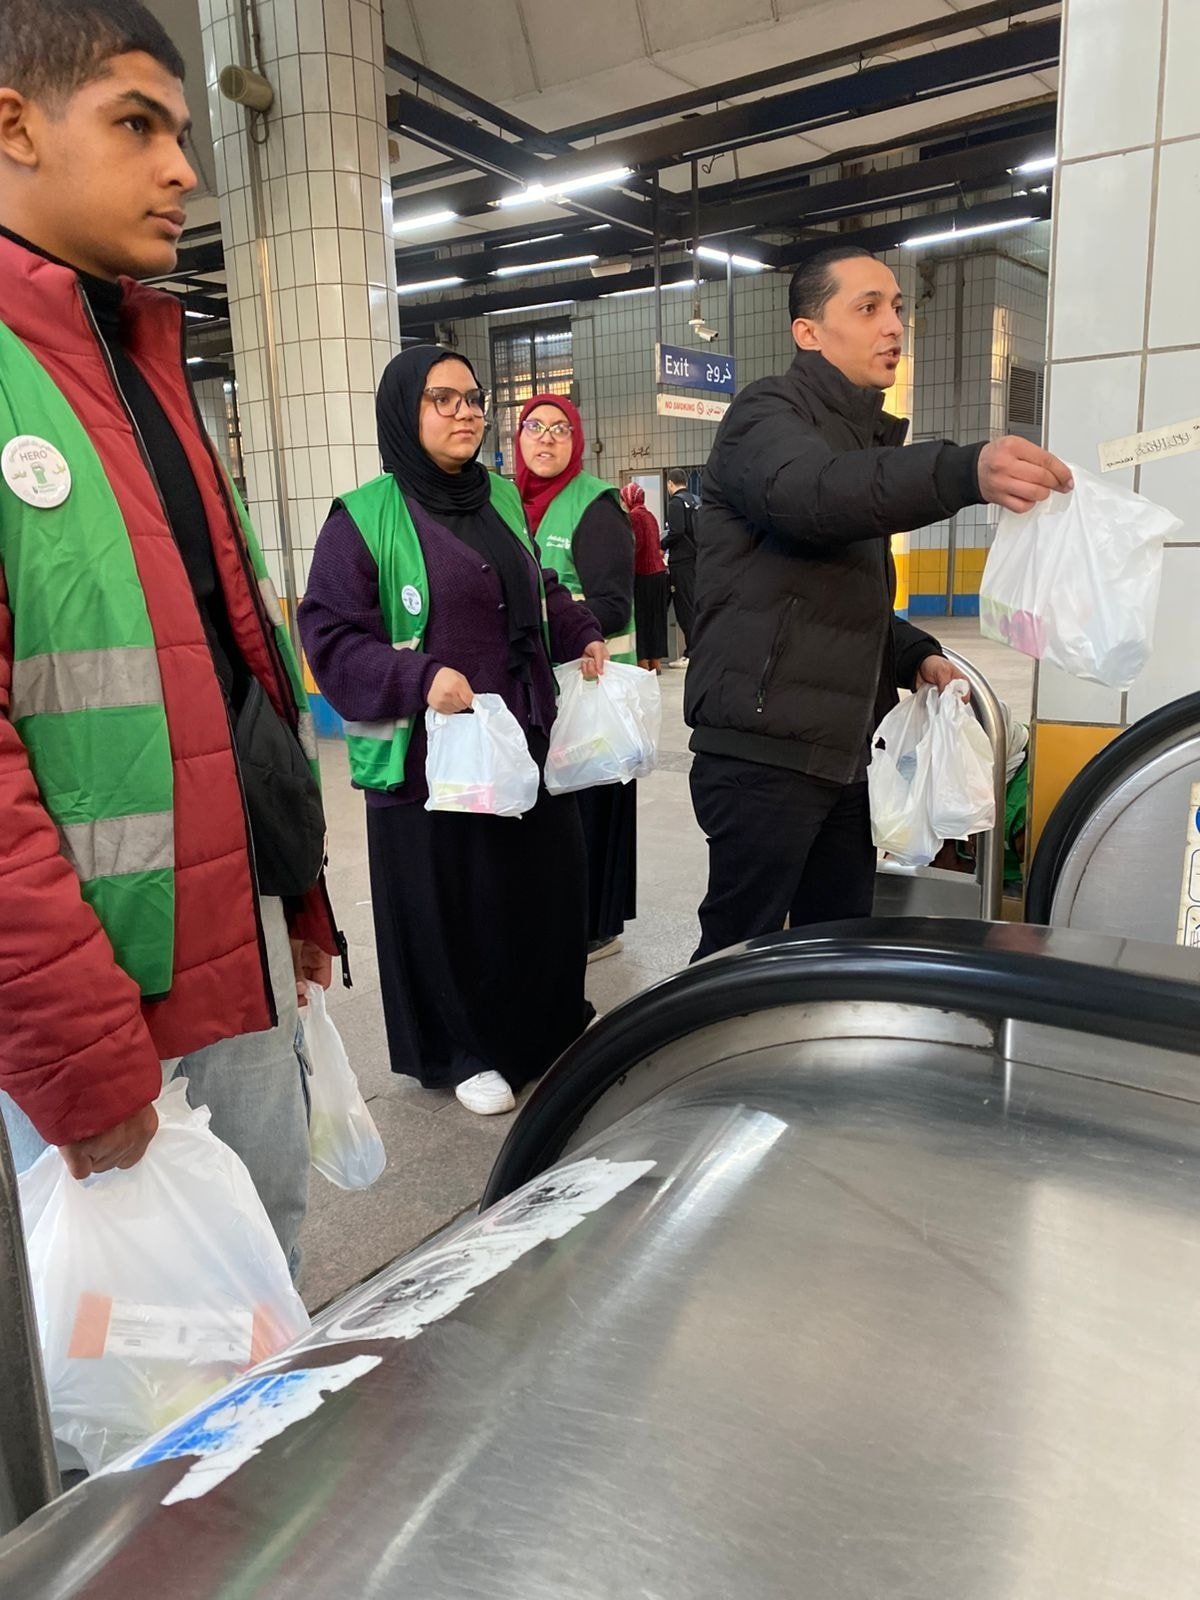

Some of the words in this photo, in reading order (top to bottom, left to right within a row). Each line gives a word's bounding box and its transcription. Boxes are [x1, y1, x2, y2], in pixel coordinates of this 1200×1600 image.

[665, 354, 689, 377] Exit
[706, 363, 732, 383] خروج
[20, 450, 47, 461] HERO
